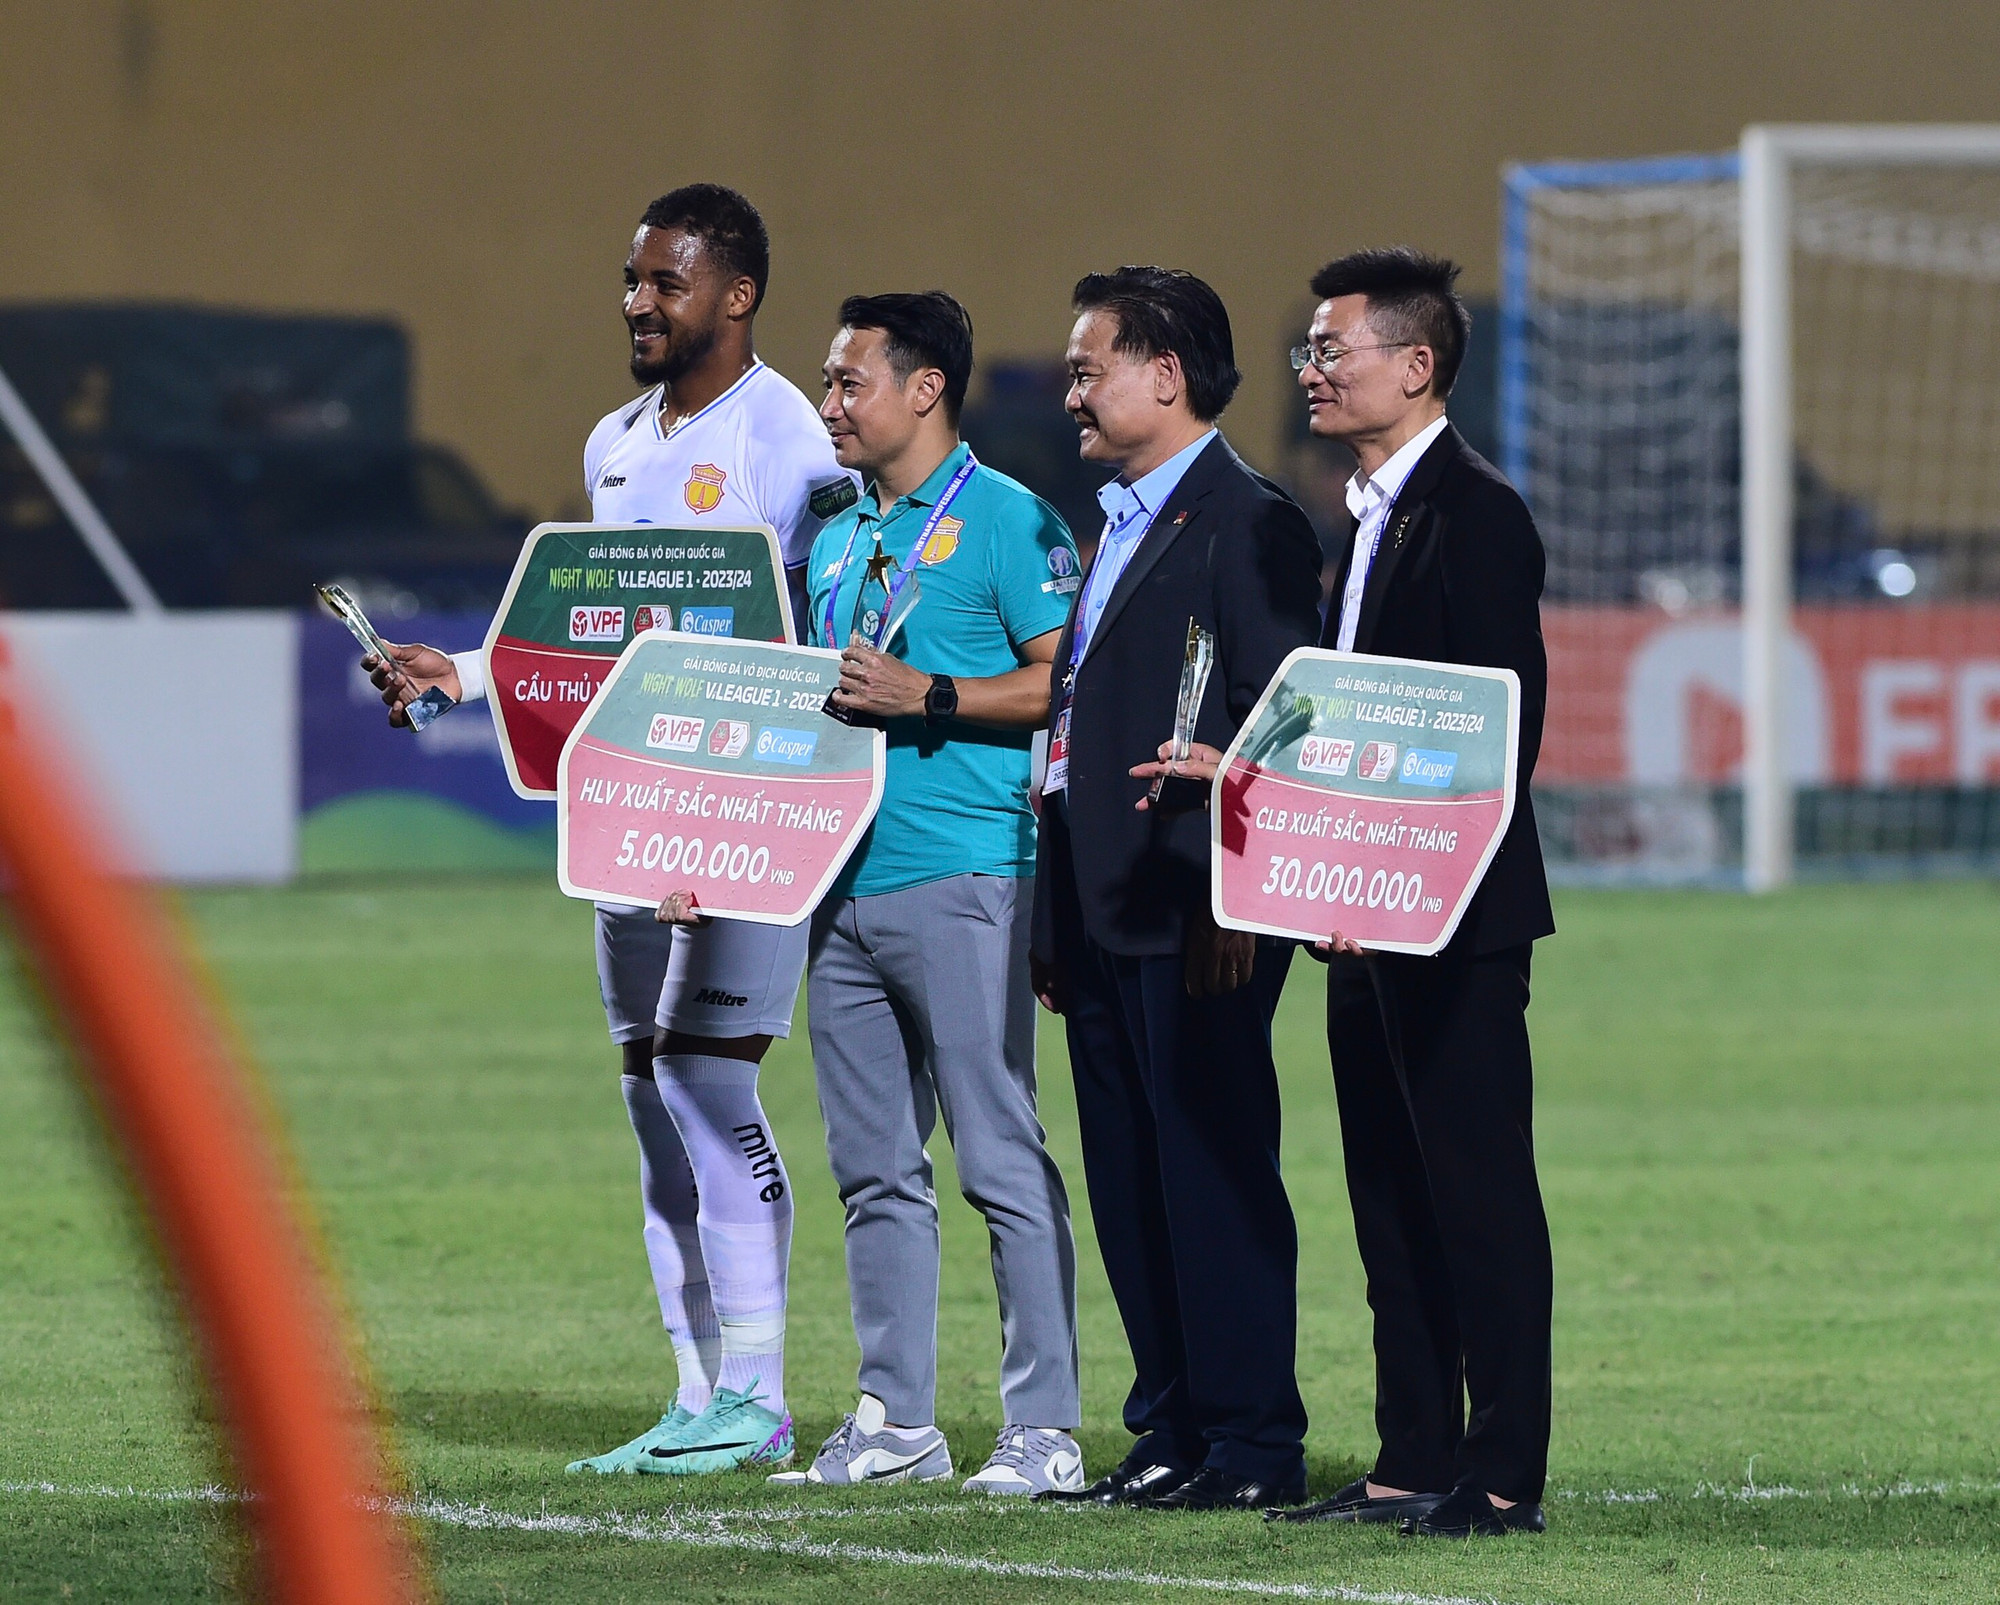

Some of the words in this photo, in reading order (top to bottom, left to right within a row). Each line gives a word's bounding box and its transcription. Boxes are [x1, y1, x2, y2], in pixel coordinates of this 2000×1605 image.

[599, 475, 626, 489] Mitre
[914, 521, 934, 552] VIETNAM
[930, 477, 963, 522] PROFESSIONAL
[588, 543, 607, 559] GIẢI
[609, 544, 634, 559] BÓNG
[636, 544, 649, 559] ĐÁ
[651, 544, 663, 559] VÔ
[665, 547, 685, 562] ĐỊCH
[687, 543, 710, 559] QUỐC
[711, 547, 725, 559] GIA
[549, 567, 582, 592] NIGHT
[585, 568, 615, 592] WOLF
[702, 569, 752, 590] 2023/24
[590, 611, 622, 633] VPF
[694, 614, 731, 636] Casper
[859, 635, 875, 648] VPF
[683, 655, 702, 670] GIẢI
[702, 657, 727, 674] BÓNG
[728, 661, 741, 675] ĐÁ
[743, 662, 755, 677] VÔ
[756, 666, 778, 681] ĐỊCH
[779, 666, 805, 682] QUỐC
[805, 671, 820, 684] GIA
[514, 671, 552, 702] CẦU
[557, 672, 591, 702] THỦ
[640, 672, 674, 696] NIGHT
[675, 676, 705, 699] WOLF
[1335, 674, 1353, 690] GIẢI
[1353, 677, 1377, 693] BÓNG
[1378, 679, 1391, 695] ĐÁ
[1392, 681, 1404, 696] VÔ
[1404, 685, 1425, 700] ĐỊCH
[1425, 684, 1448, 701] QUỐC
[1448, 690, 1463, 703] GIA
[1292, 692, 1326, 715] NIGHT
[1326, 696, 1355, 719] WOLF
[1433, 711, 1485, 735] 2023/24
[669, 719, 702, 743] VPF
[771, 736, 814, 760] Casper
[1320, 741, 1352, 767] VPF
[1415, 757, 1454, 782] Casper
[579, 777, 619, 803] HLV
[619, 777, 676, 812] XUẤT
[676, 781, 716, 818] SẮC
[717, 789, 774, 826] NHẤT
[775, 799, 843, 833] THÁNG
[1255, 806, 1287, 832] CLB
[1288, 807, 1331, 838] XUẤT
[1332, 810, 1362, 842] SẮC
[1364, 816, 1407, 848] NHẤT
[1407, 824, 1458, 853] THÁNG
[615, 829, 770, 885] 5.000.000
[769, 868, 794, 886] VNĐ
[1262, 855, 1423, 913] 30.000.000
[1421, 895, 1443, 914] VNĐ
[693, 988, 748, 1007] Mitre
[733, 1122, 784, 1204] mitre
